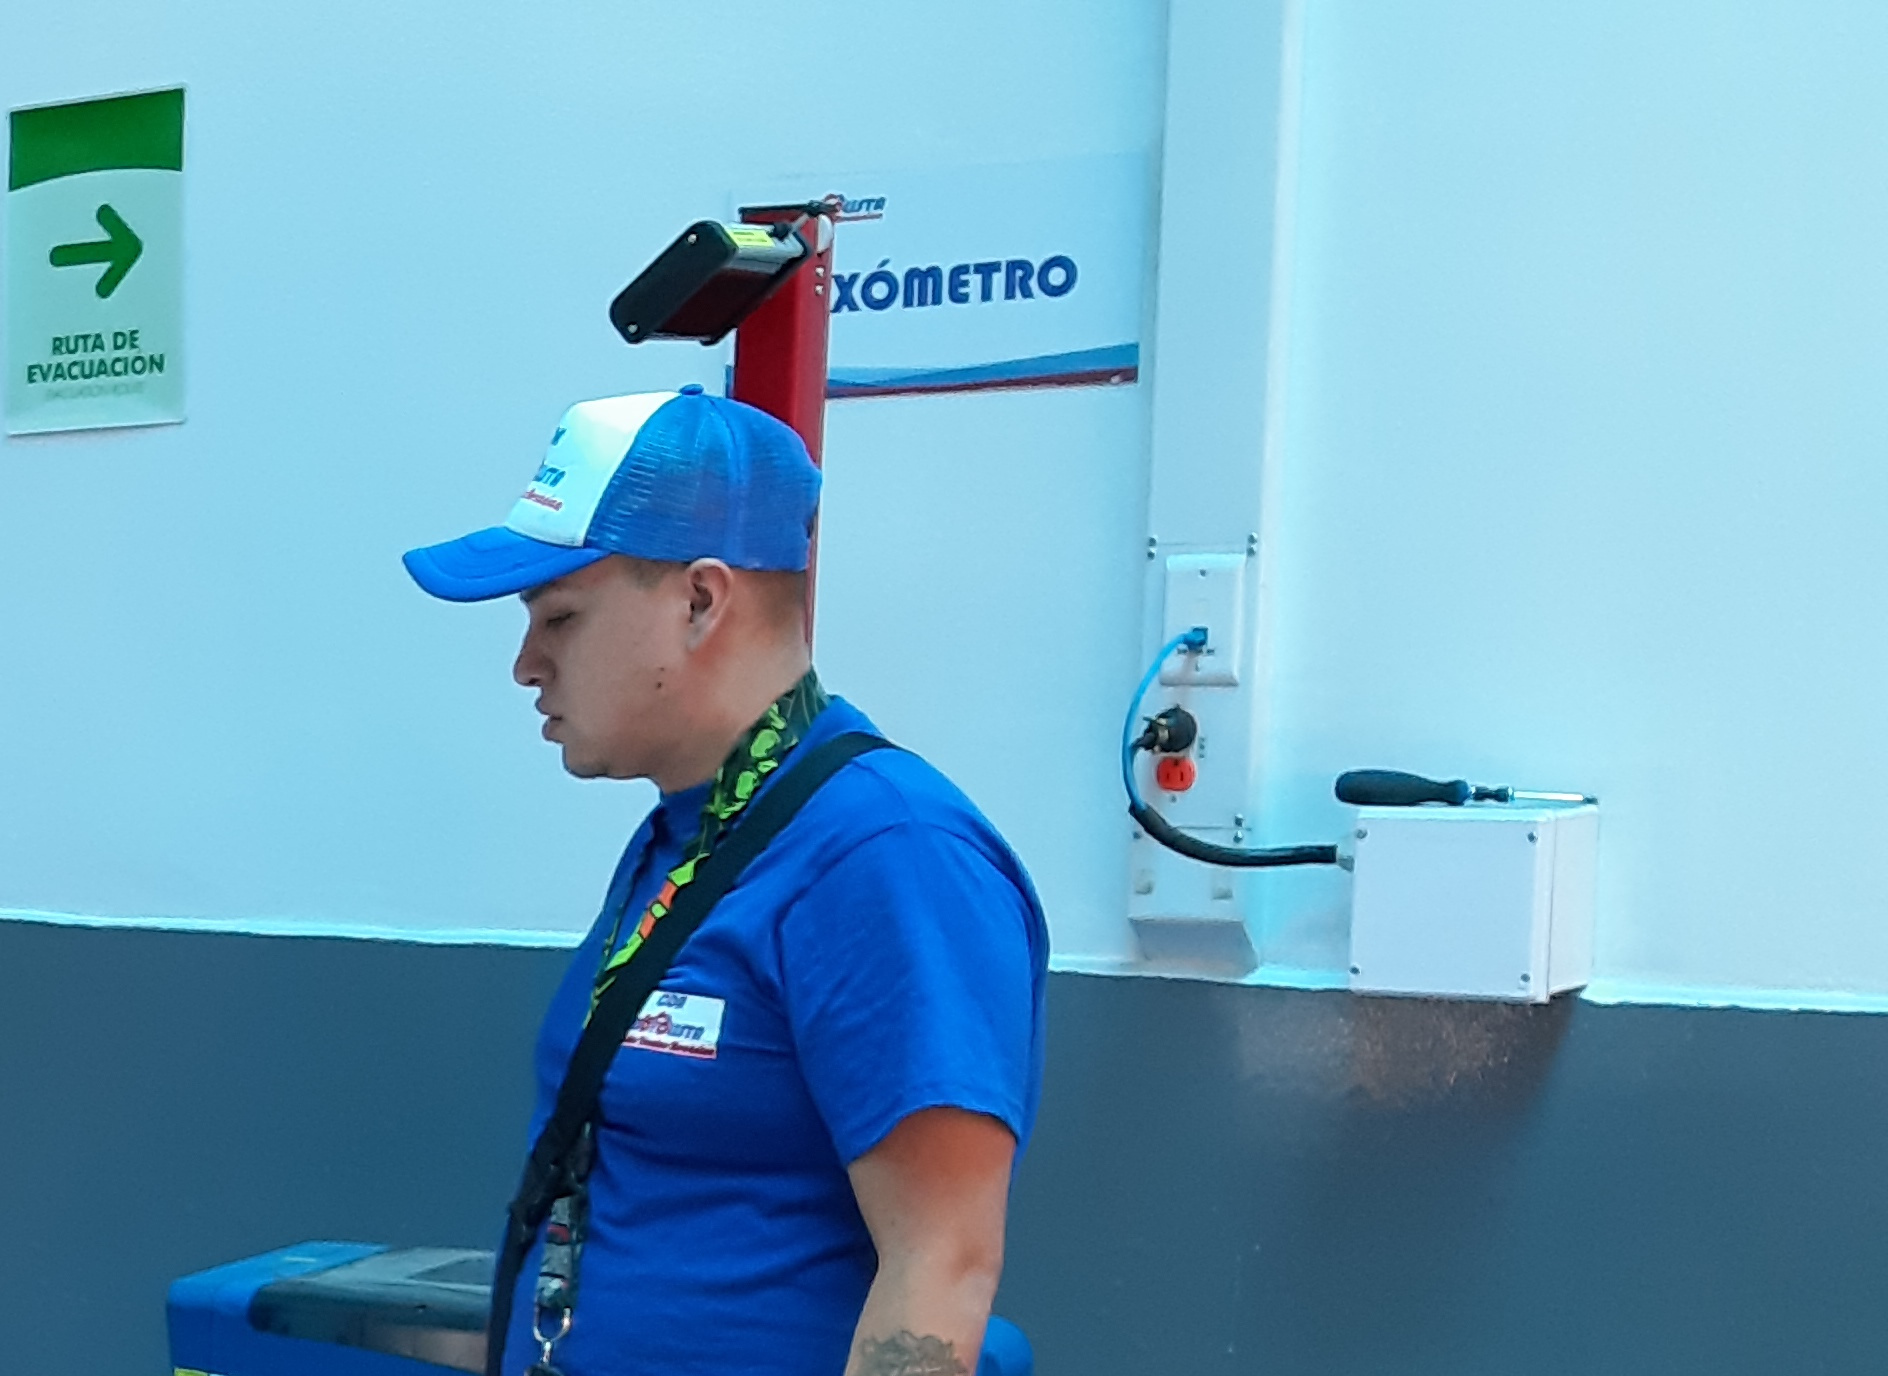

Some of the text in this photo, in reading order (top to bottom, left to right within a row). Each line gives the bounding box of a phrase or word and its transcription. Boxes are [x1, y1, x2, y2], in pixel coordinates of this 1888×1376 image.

[831, 254, 1078, 313] XÓMETRO
[52, 329, 140, 356] RUTA DE
[26, 353, 165, 384] EVACUACION
